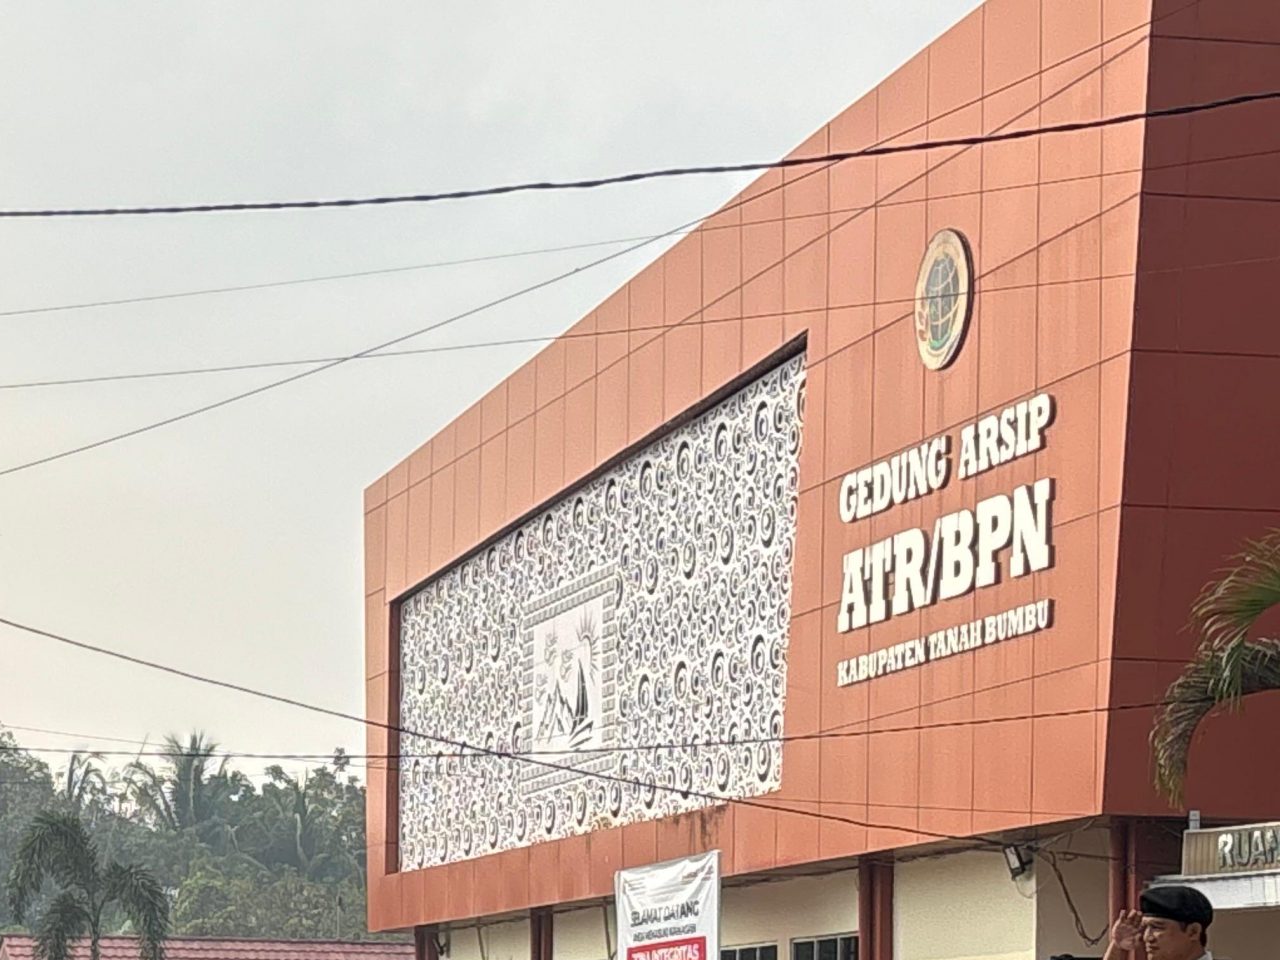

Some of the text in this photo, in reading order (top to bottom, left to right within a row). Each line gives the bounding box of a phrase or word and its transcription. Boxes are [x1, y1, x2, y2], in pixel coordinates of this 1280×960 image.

[839, 393, 1054, 523] GEDUNG ARSIP
[837, 478, 1054, 633] ATR/BPN
[837, 599, 1053, 687] KABUPATEN TANAH BUMBU
